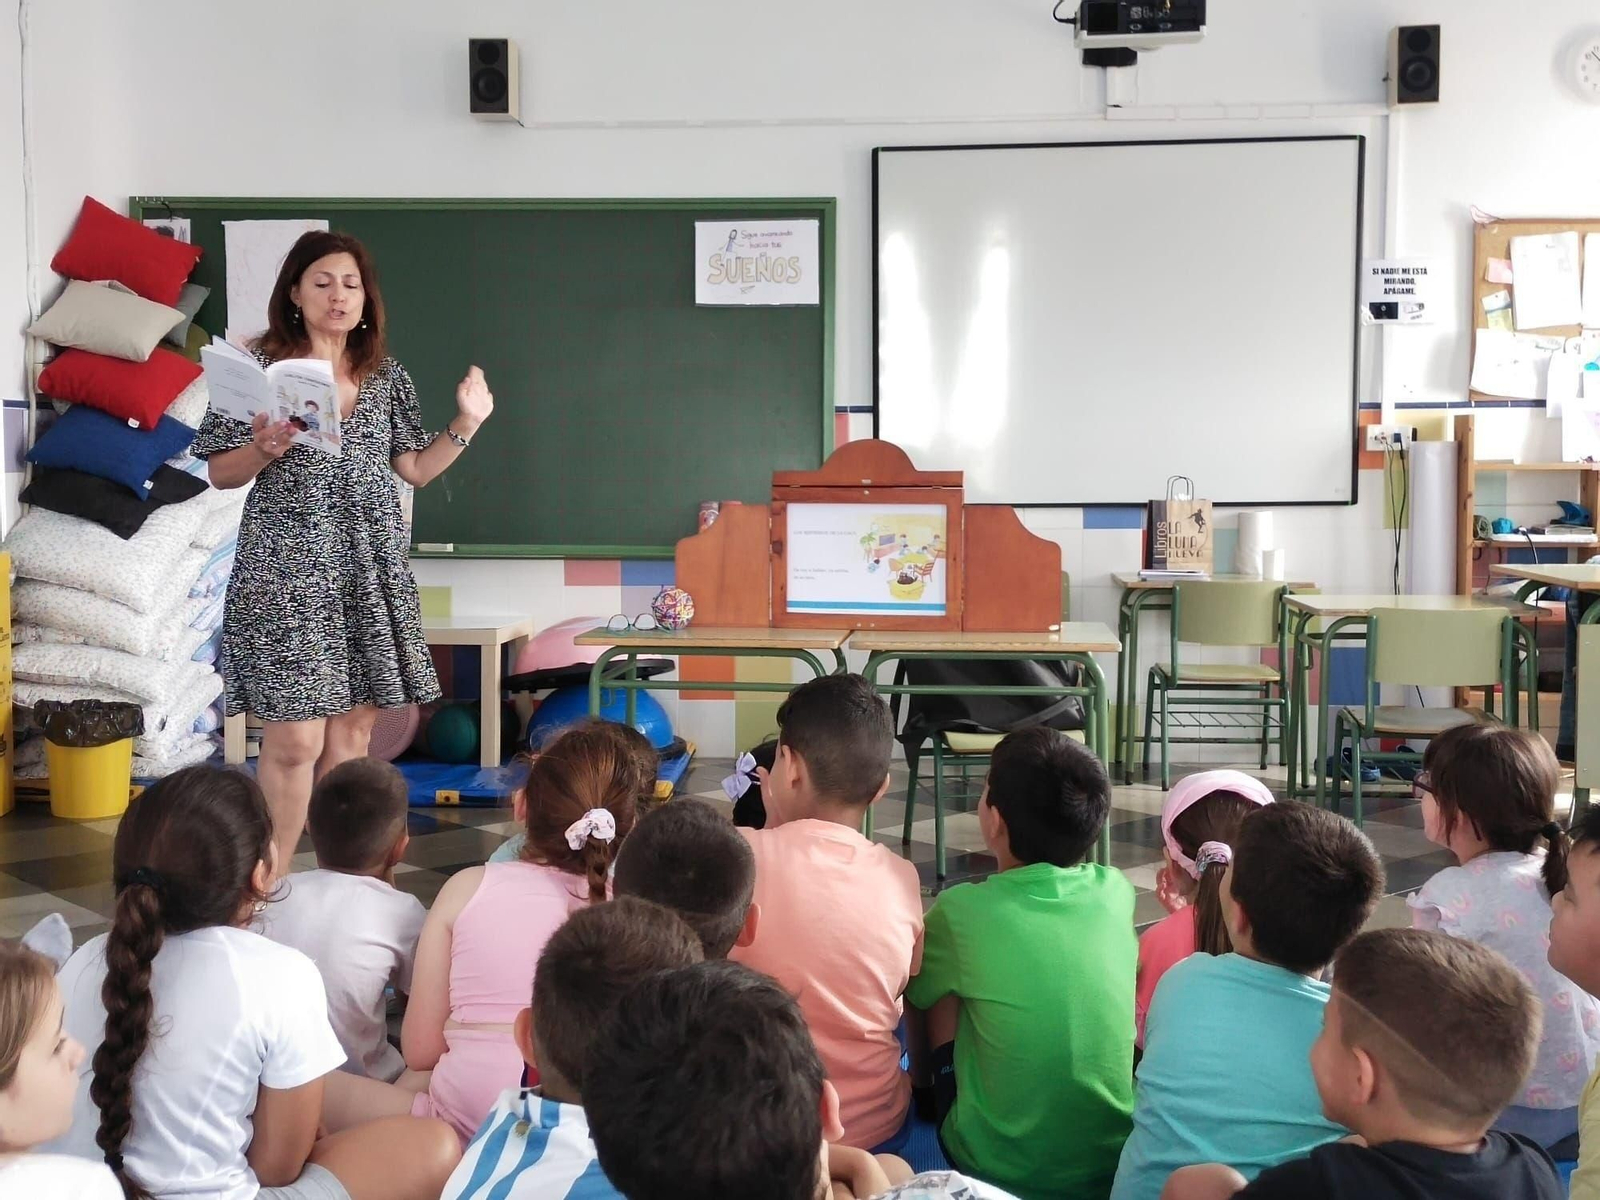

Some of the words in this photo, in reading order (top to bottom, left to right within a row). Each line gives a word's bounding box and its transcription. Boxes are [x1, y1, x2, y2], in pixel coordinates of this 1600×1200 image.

[707, 252, 802, 285] SUEÑOS
[1372, 267, 1379, 275] SI
[1380, 267, 1400, 275] NADIE
[1401, 267, 1411, 275] ME
[1168, 521, 1181, 535] LA
[1154, 522, 1167, 558] Libros
[1168, 536, 1197, 549] LUNA
[1168, 549, 1204, 558] NUEVA
